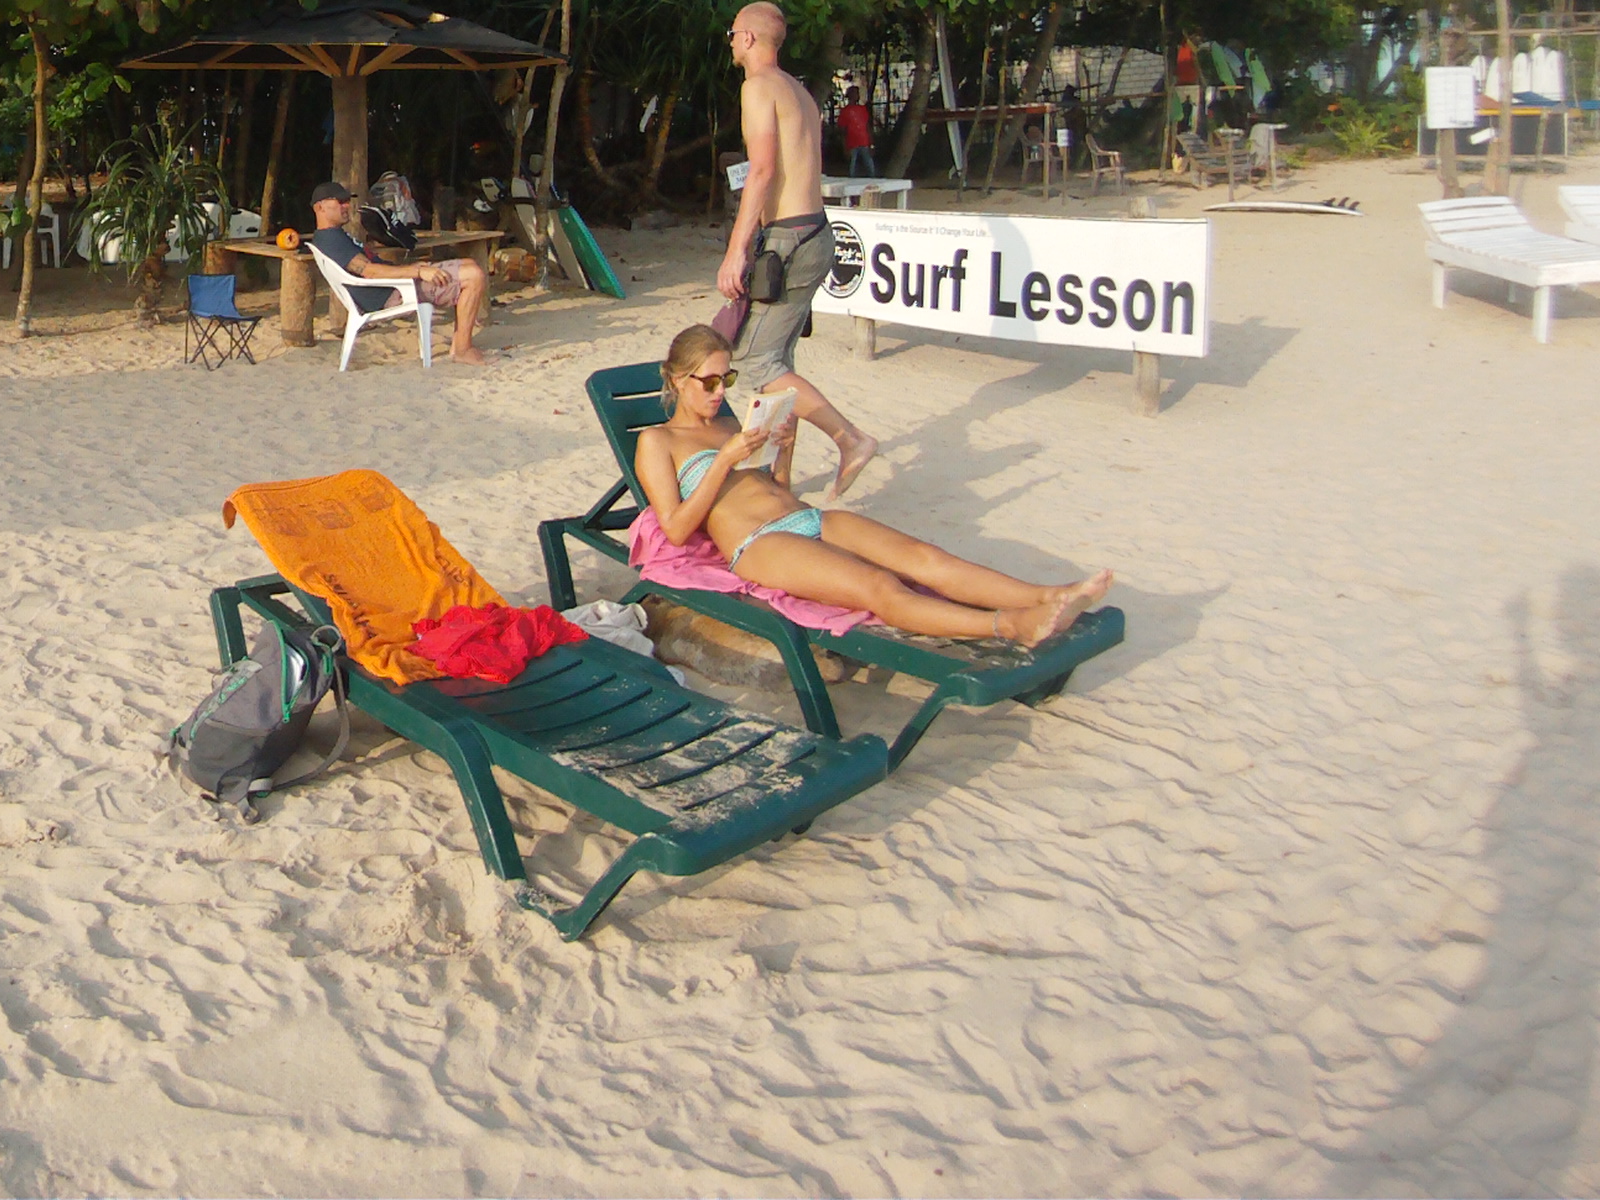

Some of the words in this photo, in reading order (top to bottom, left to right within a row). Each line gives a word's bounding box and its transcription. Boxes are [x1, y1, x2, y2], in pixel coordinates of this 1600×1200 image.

[939, 226, 961, 238] Change
[962, 228, 975, 237] Your
[869, 242, 968, 312] Surf
[989, 251, 1194, 335] Lesson
